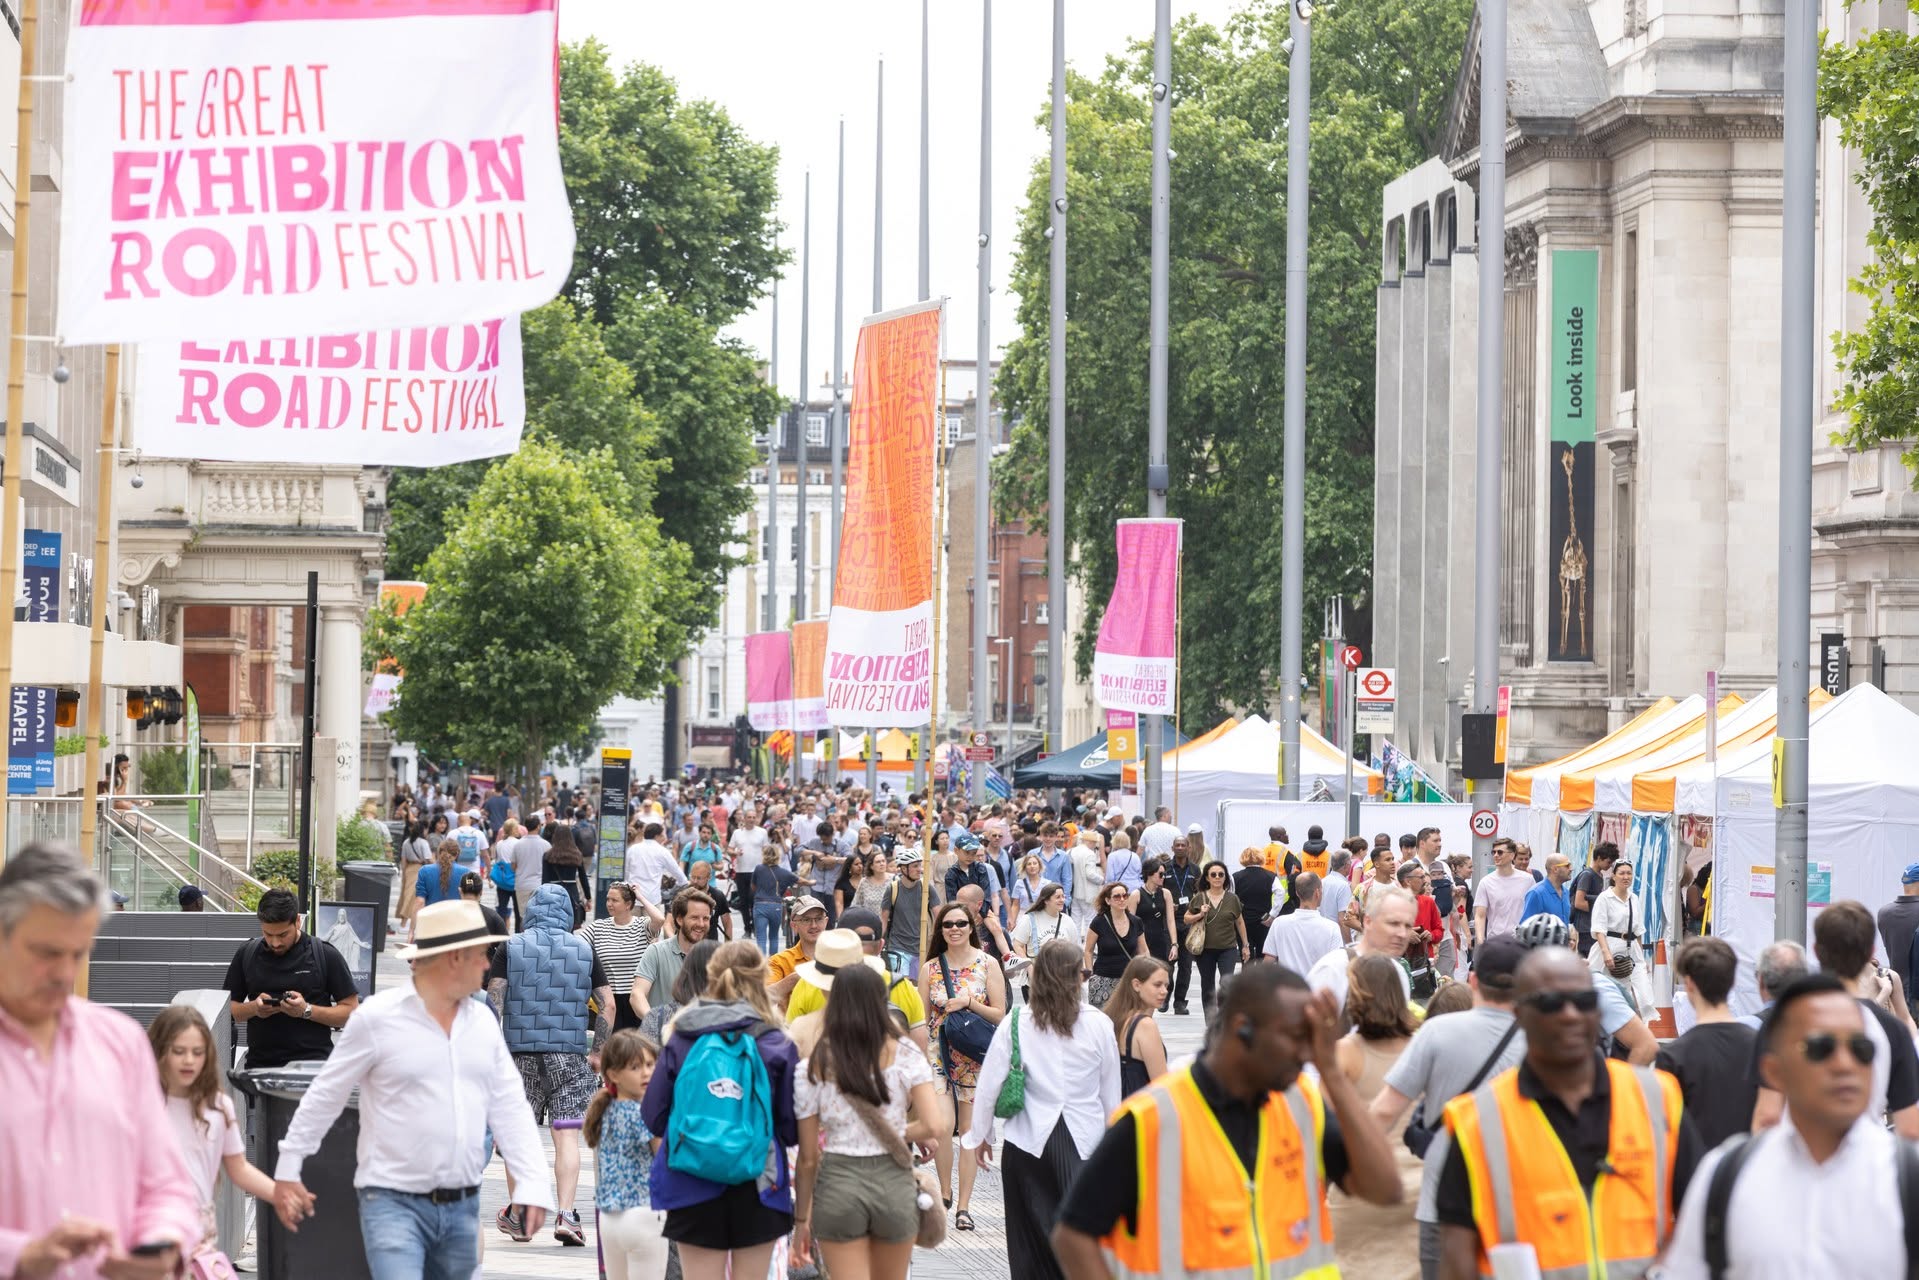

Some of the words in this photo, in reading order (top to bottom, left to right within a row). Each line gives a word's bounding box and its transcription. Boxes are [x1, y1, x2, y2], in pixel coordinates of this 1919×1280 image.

[113, 70, 189, 141] THE
[197, 64, 329, 139] GREAT
[111, 134, 526, 221] EXHIBITION
[104, 222, 322, 300] ROAD
[334, 211, 545, 291] FESTIVAL
[1567, 306, 1583, 366] inside
[176, 368, 351, 429] ROAD
[361, 375, 504, 433] FESTIVAL
[1567, 371, 1583, 419] Look
[1345, 650, 1357, 665] K
[1115, 736, 1128, 752] 3
[1475, 817, 1494, 830] 20
[1306, 860, 1326, 868] SECURITY
